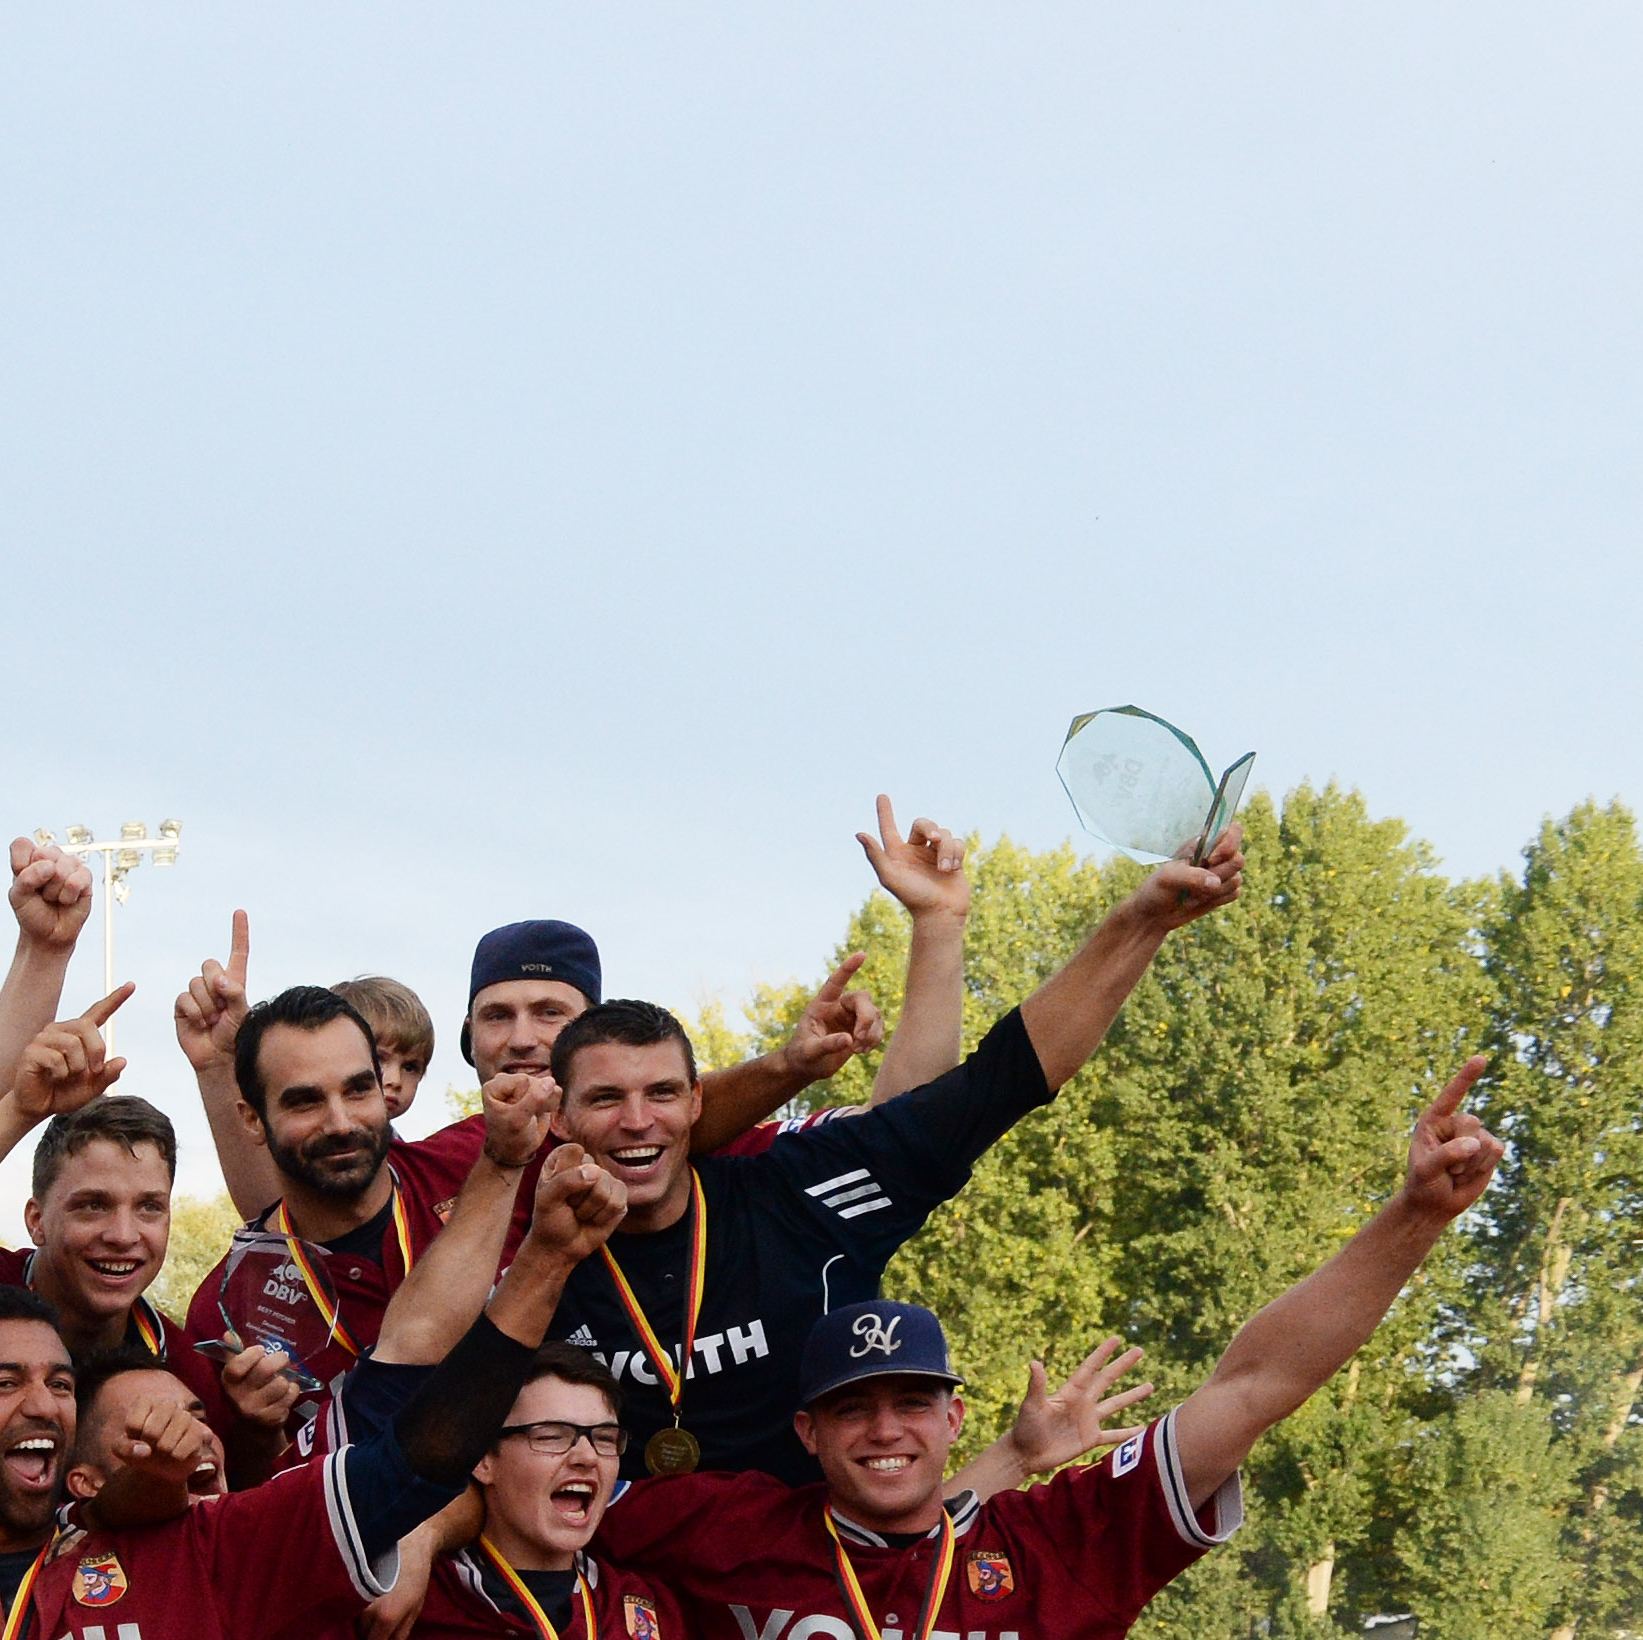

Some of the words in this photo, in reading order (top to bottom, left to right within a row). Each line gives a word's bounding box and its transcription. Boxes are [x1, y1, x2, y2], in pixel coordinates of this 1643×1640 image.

[521, 963, 552, 973] VOITH
[263, 1279, 304, 1305] DBV
[565, 1337, 597, 1347] adidas
